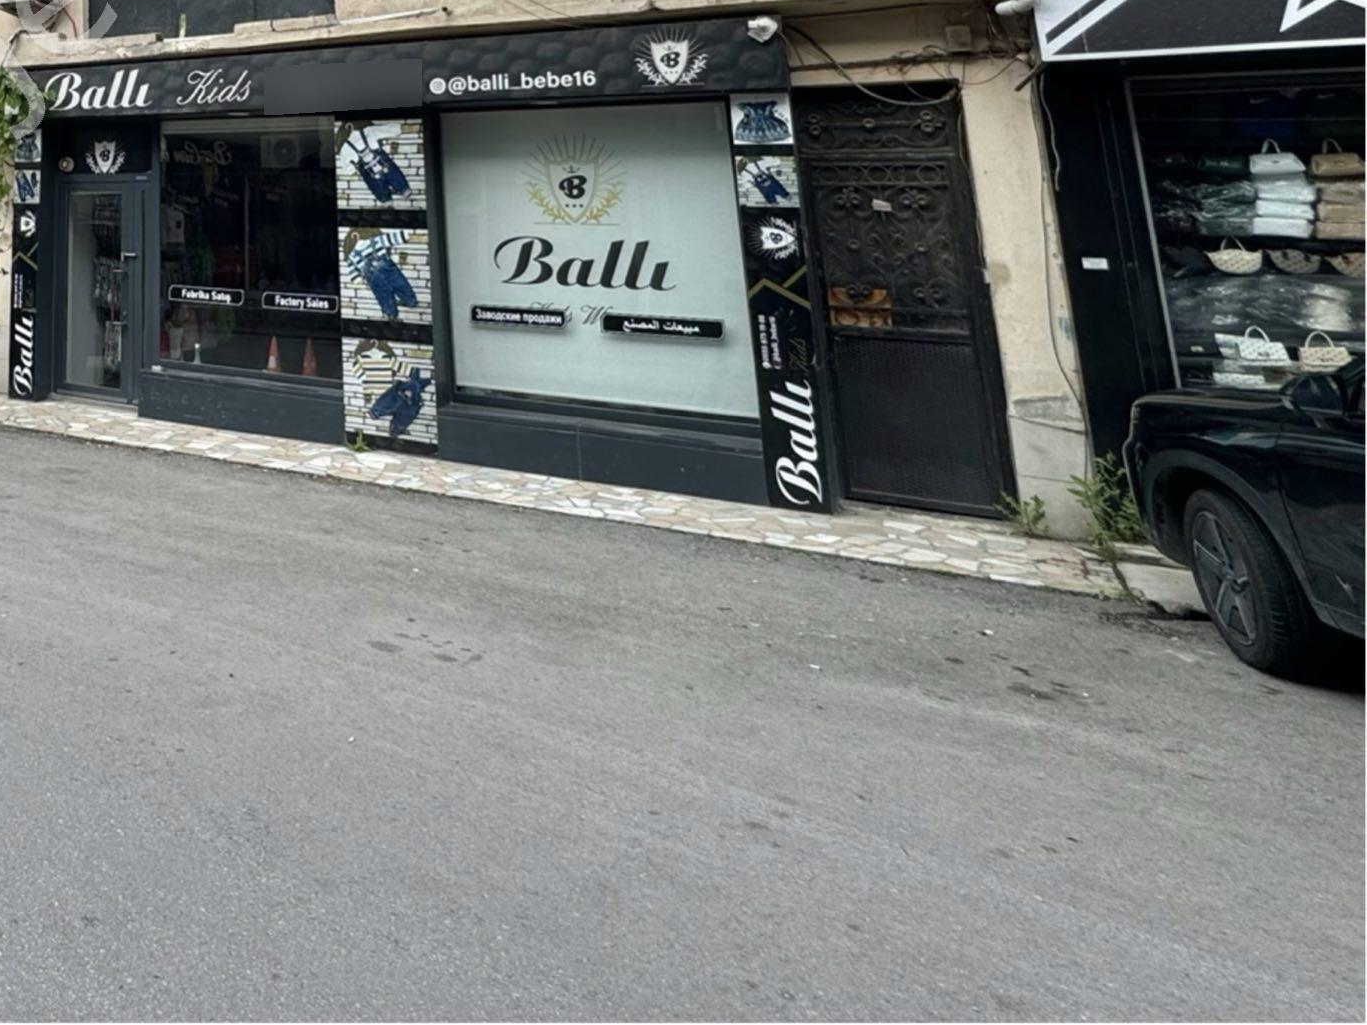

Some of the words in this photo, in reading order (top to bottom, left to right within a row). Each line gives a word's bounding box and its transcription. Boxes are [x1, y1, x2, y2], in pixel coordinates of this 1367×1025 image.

[176, 68, 252, 105] Kids
[448, 70, 596, 95] @balli_bebe16
[559, 175, 587, 199] B
[181, 289, 210, 301] Fabrika
[275, 295, 304, 310] Factory
[306, 298, 329, 309] Sales
[475, 307, 521, 323] Заводские
[522, 313, 563, 325] продажи
